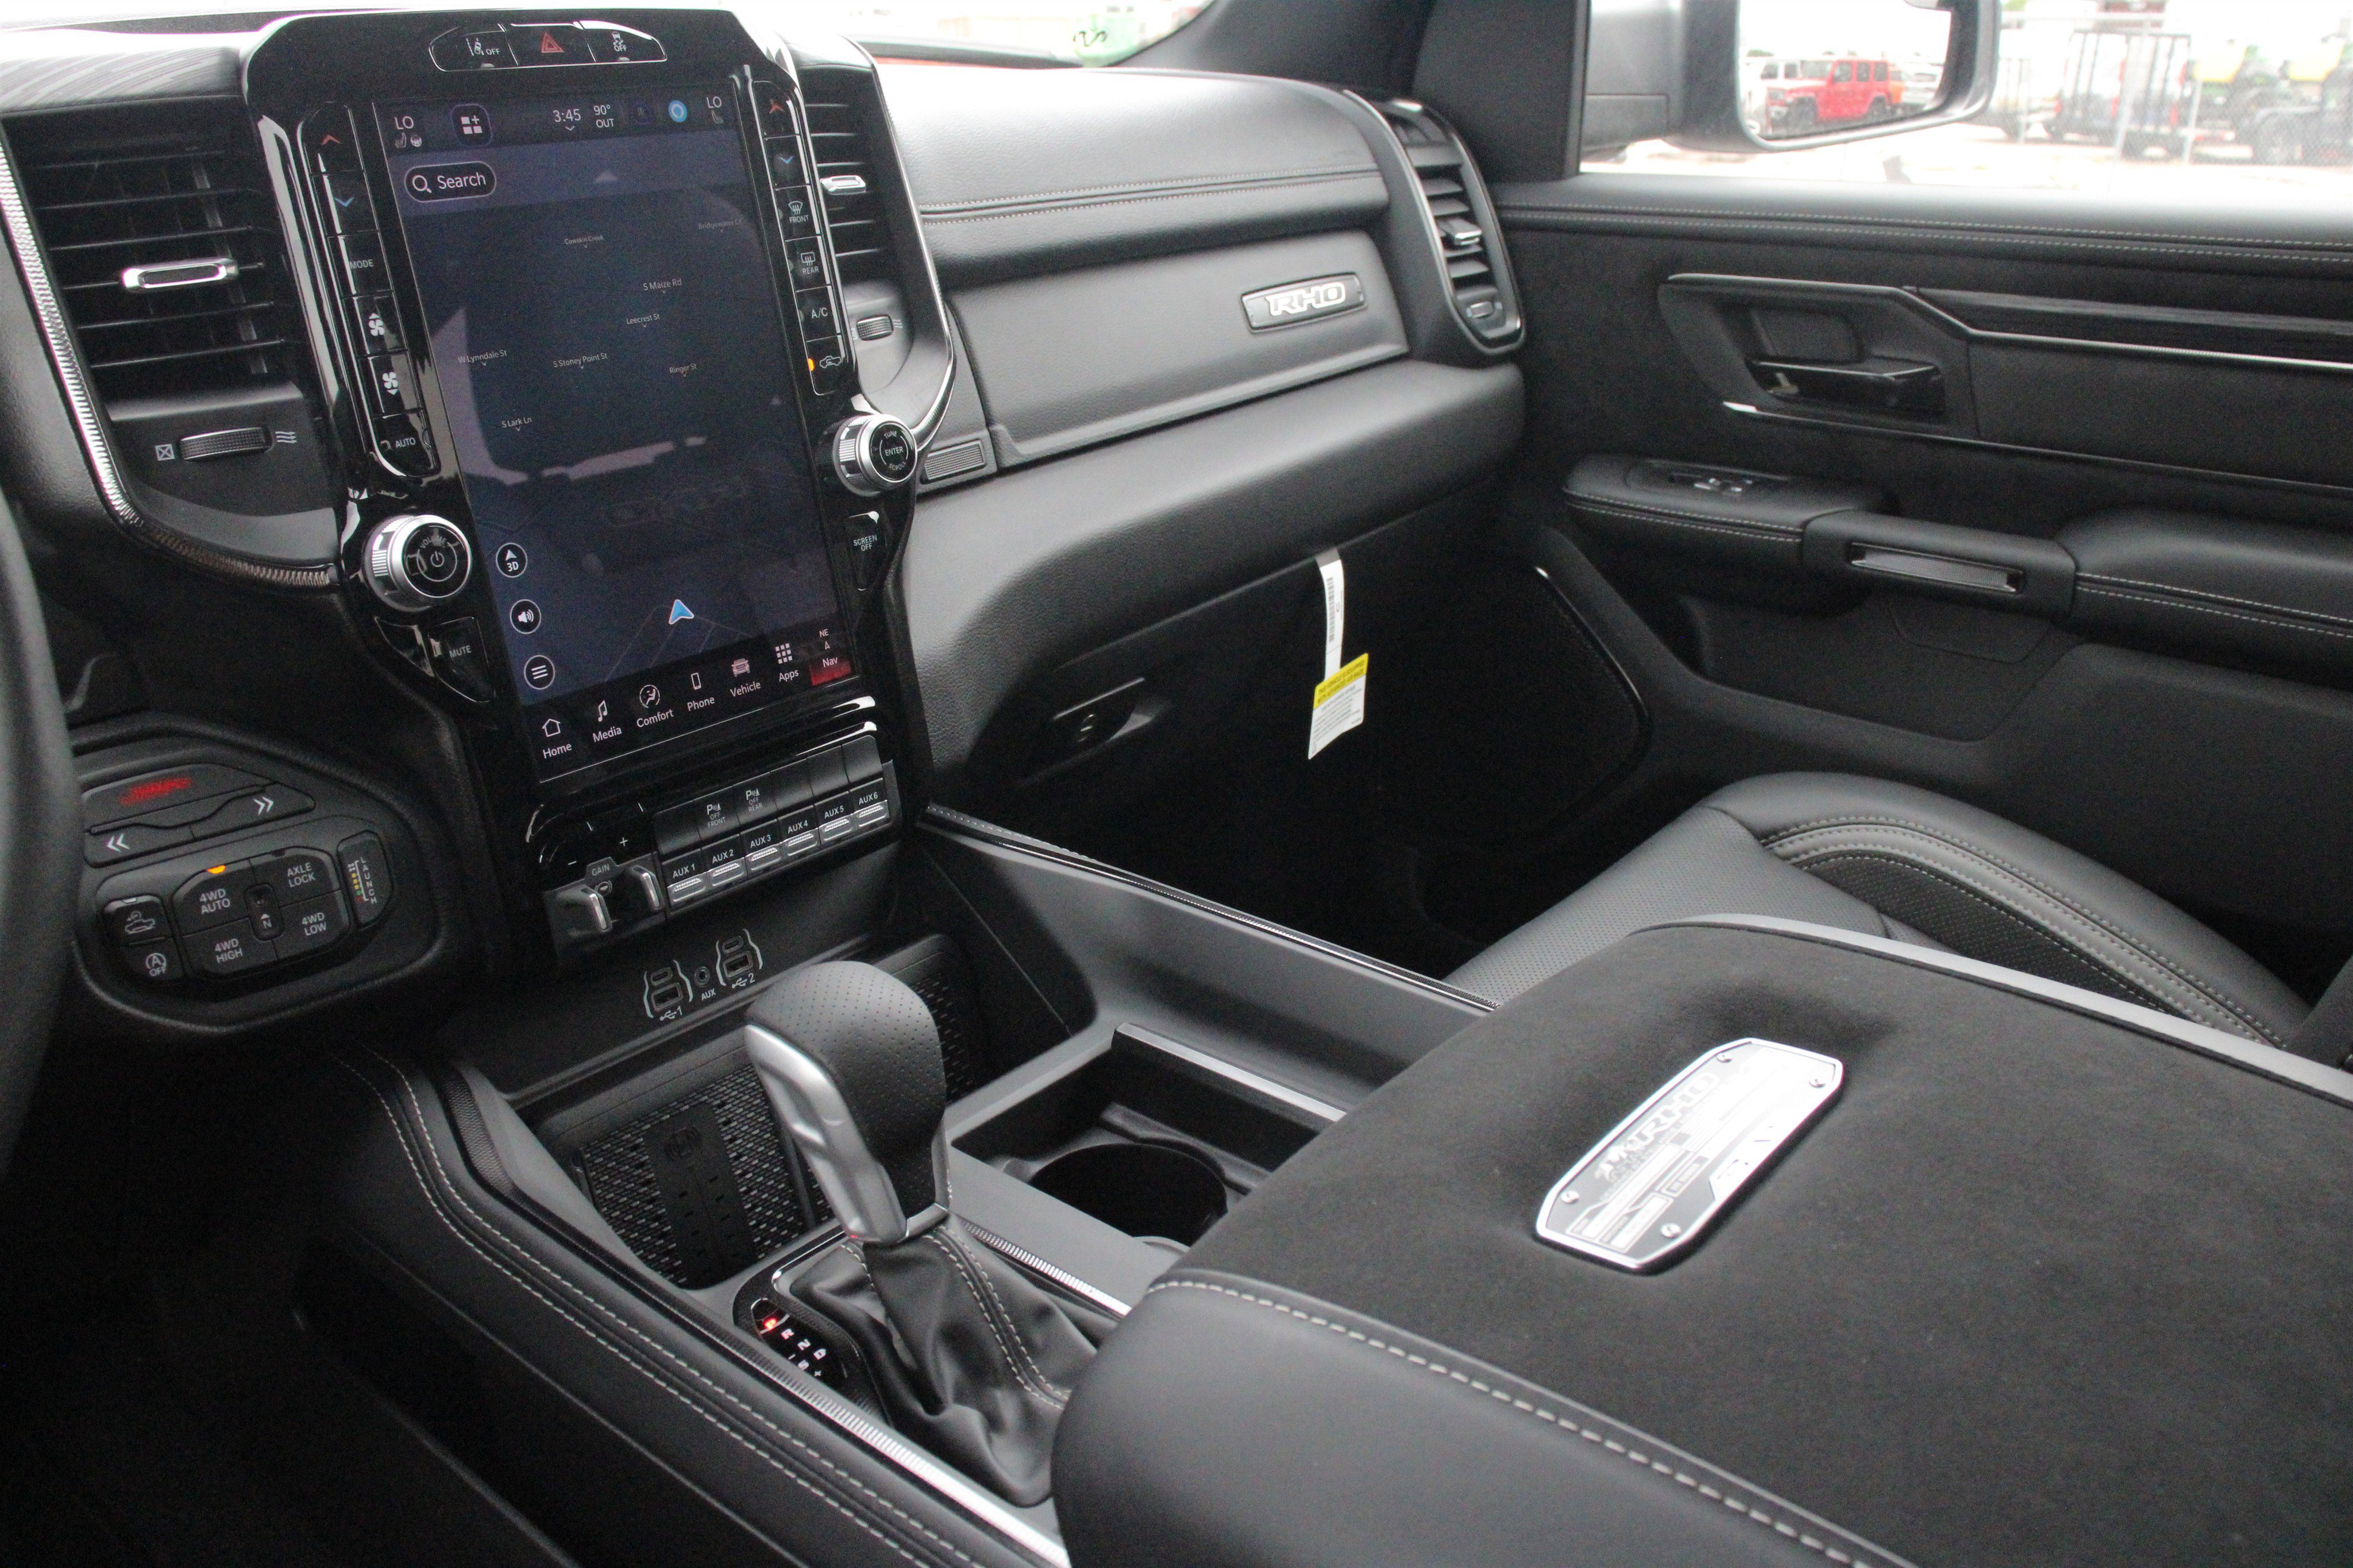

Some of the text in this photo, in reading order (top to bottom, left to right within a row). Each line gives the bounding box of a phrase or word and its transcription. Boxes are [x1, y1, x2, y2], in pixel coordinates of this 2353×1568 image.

[485, 48, 500, 56] OFF
[614, 44, 627, 53] OFF
[706, 96, 722, 109] LO
[553, 108, 581, 123] 3:45
[394, 115, 414, 130] LO
[596, 118, 615, 128] OUT
[437, 172, 486, 190] Search
[789, 214, 809, 223] FRONT
[349, 258, 374, 269] MODE
[802, 267, 819, 275] REAR
[643, 278, 682, 291] S Maize Rd
[1266, 281, 1345, 316] RHO
[653, 313, 660, 321] St
[811, 307, 828, 318] A/C
[466, 352, 499, 364] Lynndale
[500, 349, 507, 357] St
[558, 356, 582, 368] Stoney
[582, 353, 600, 364] Point
[601, 352, 608, 360] St
[669, 363, 697, 374] Ringer St
[507, 418, 523, 427] Lark
[523, 416, 532, 424] Ln
[883, 430, 898, 438] TUNE
[395, 437, 416, 449] AUTO
[885, 445, 904, 457] ENTER
[888, 461, 907, 472] SCROLL
[853, 534, 877, 546] SCREEN
[861, 542, 873, 551] OFF
[506, 561, 519, 573] 3D
[819, 628, 830, 638] NE
[449, 644, 472, 659] MUTE
[822, 655, 838, 668] Nav
[778, 669, 799, 683] Apps
[730, 680, 761, 698] Vehicle
[687, 695, 715, 712] Phone
[637, 708, 674, 728] Comfort
[592, 725, 622, 743] Media
[542, 741, 572, 759] Home
[858, 794, 873, 805] AUX
[824, 808, 839, 819] AUX
[788, 822, 802, 833] AUX
[750, 837, 765, 848] AUX
[712, 852, 728, 863] AUX
[287, 863, 313, 878] AXLE
[591, 863, 610, 877] GAIN
[672, 866, 689, 878] AUX
[288, 872, 317, 889] LOCK
[199, 889, 226, 904] 4WD
[200, 898, 230, 915] AUTO
[263, 920, 272, 929] N
[302, 912, 325, 926] 4WD
[304, 921, 327, 937] LOW
[214, 939, 239, 953] 4WD
[216, 947, 243, 963] HIGH
[149, 966, 167, 976] OFF
[701, 988, 716, 1001] AUX
